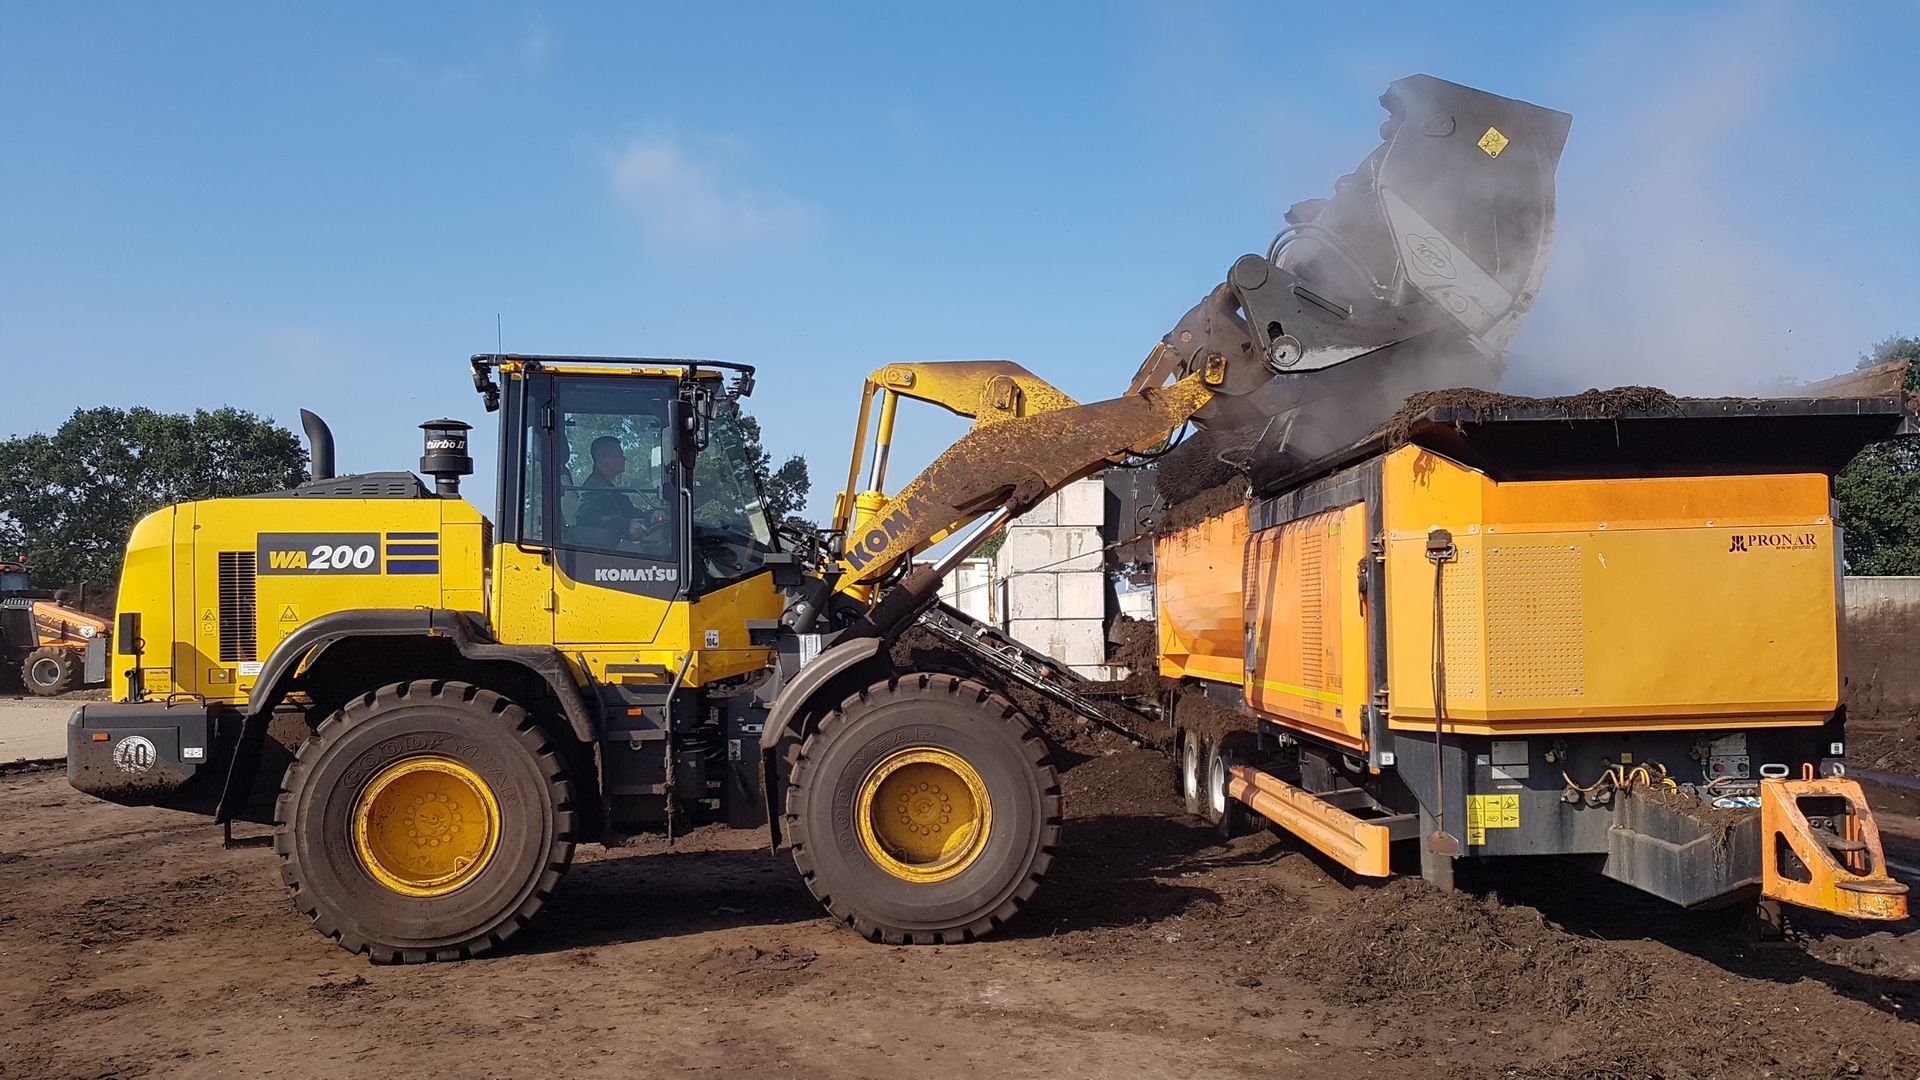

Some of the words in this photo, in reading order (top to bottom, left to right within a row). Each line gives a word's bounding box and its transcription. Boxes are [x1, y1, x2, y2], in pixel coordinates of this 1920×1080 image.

[426, 439, 455, 449] turbo
[844, 478, 935, 572] KOMAT
[1748, 534, 1816, 546] PRONAR
[595, 565, 677, 581] KOMATSU
[121, 743, 147, 768] 40
